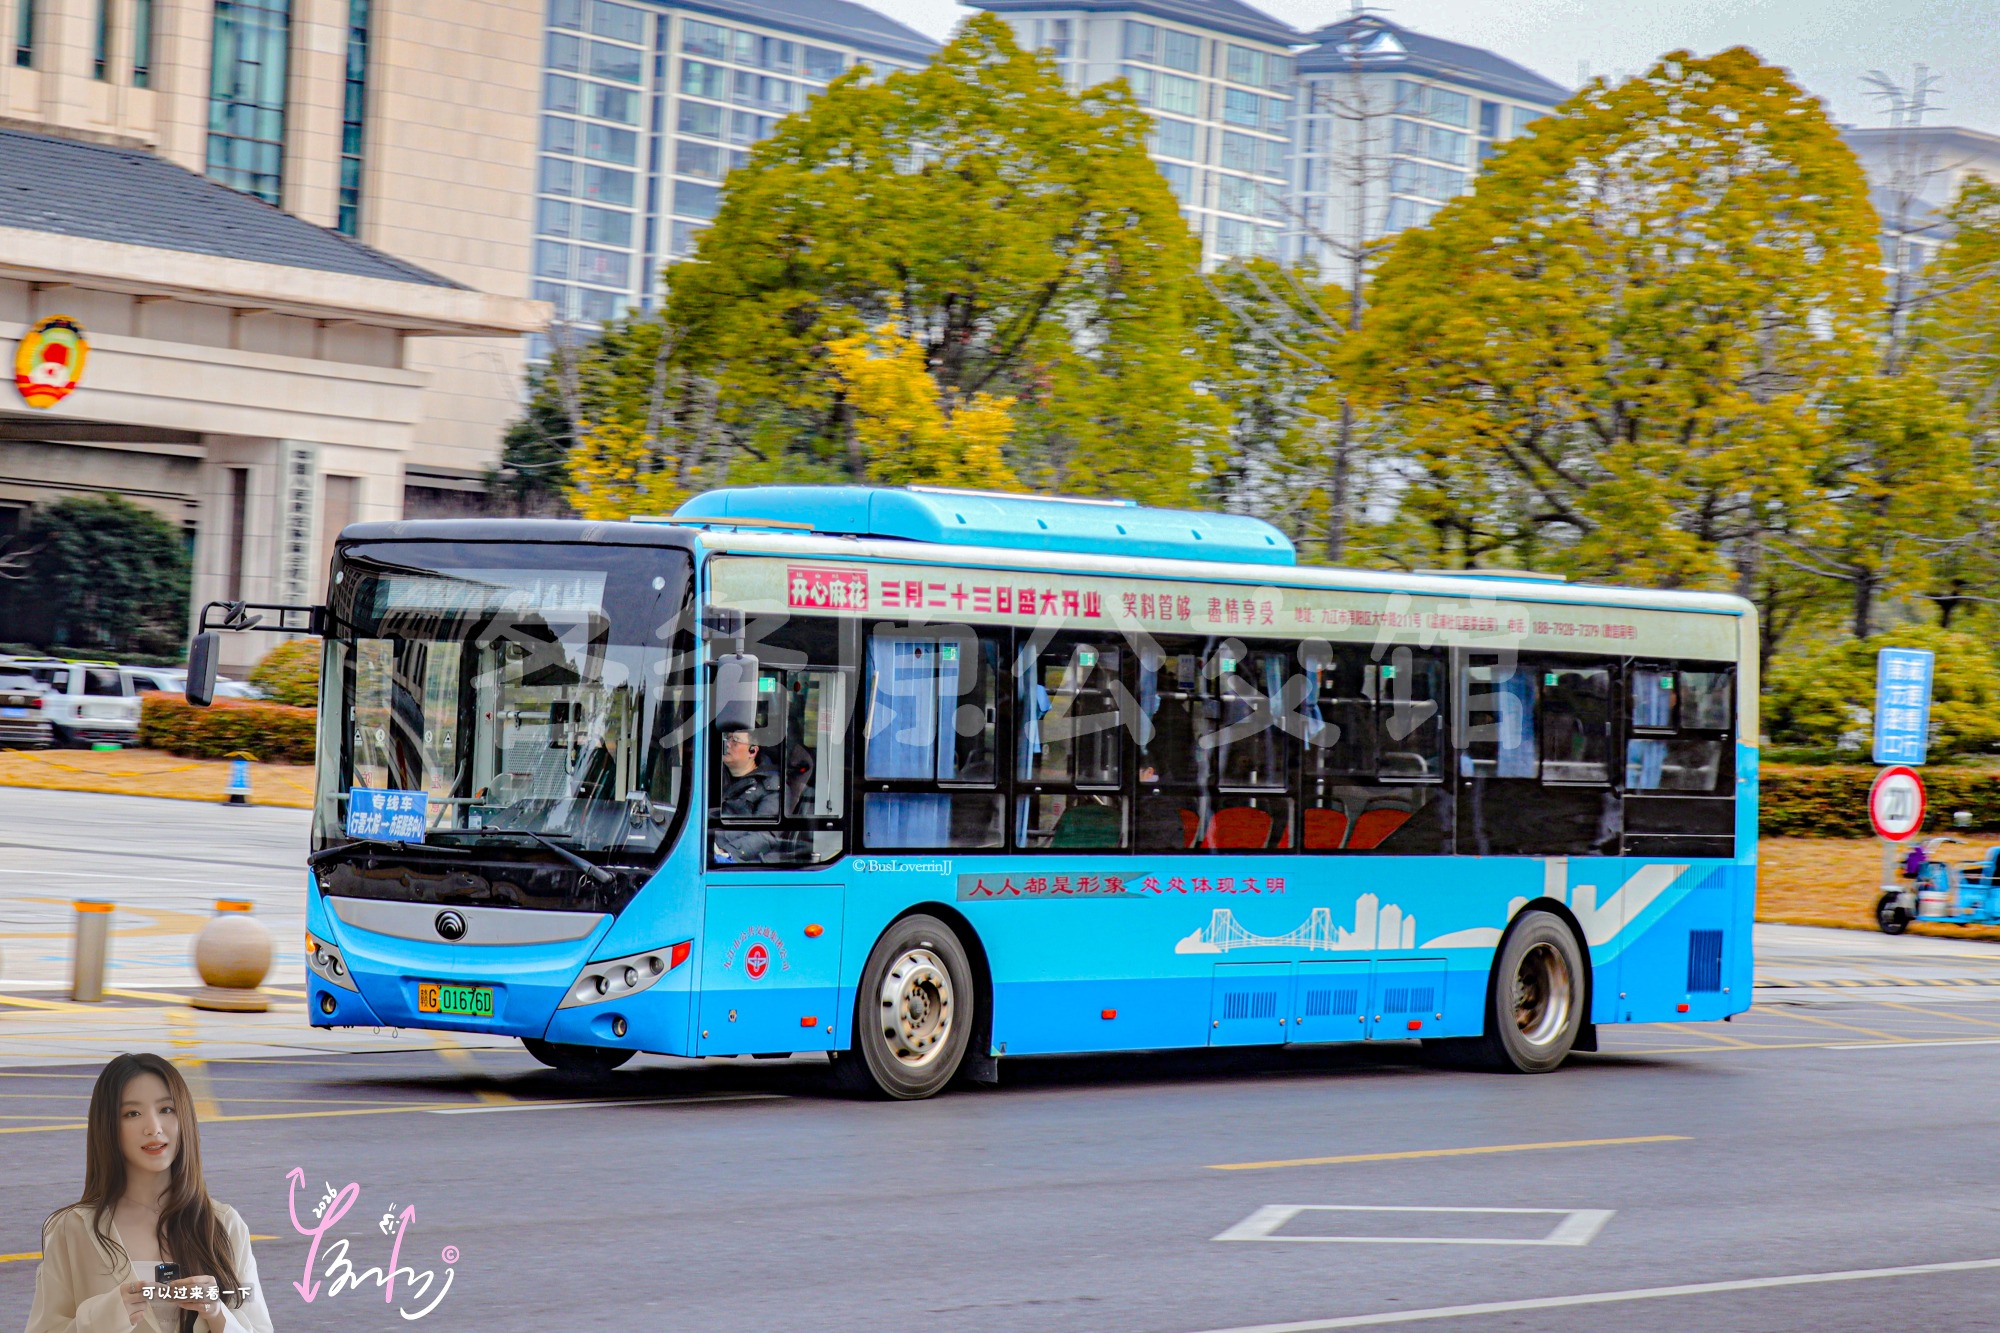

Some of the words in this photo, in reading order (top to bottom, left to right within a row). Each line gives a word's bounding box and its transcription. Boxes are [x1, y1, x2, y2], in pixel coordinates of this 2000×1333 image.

[791, 578, 866, 608] 开心麻花
[881, 581, 1101, 617] 三月二十三日盛大开业
[1122, 592, 1191, 621] 笑料管够
[372, 793, 413, 812] 专线车
[968, 876, 1127, 897] 人人都是形象
[1141, 876, 1286, 895] 处处体现文明
